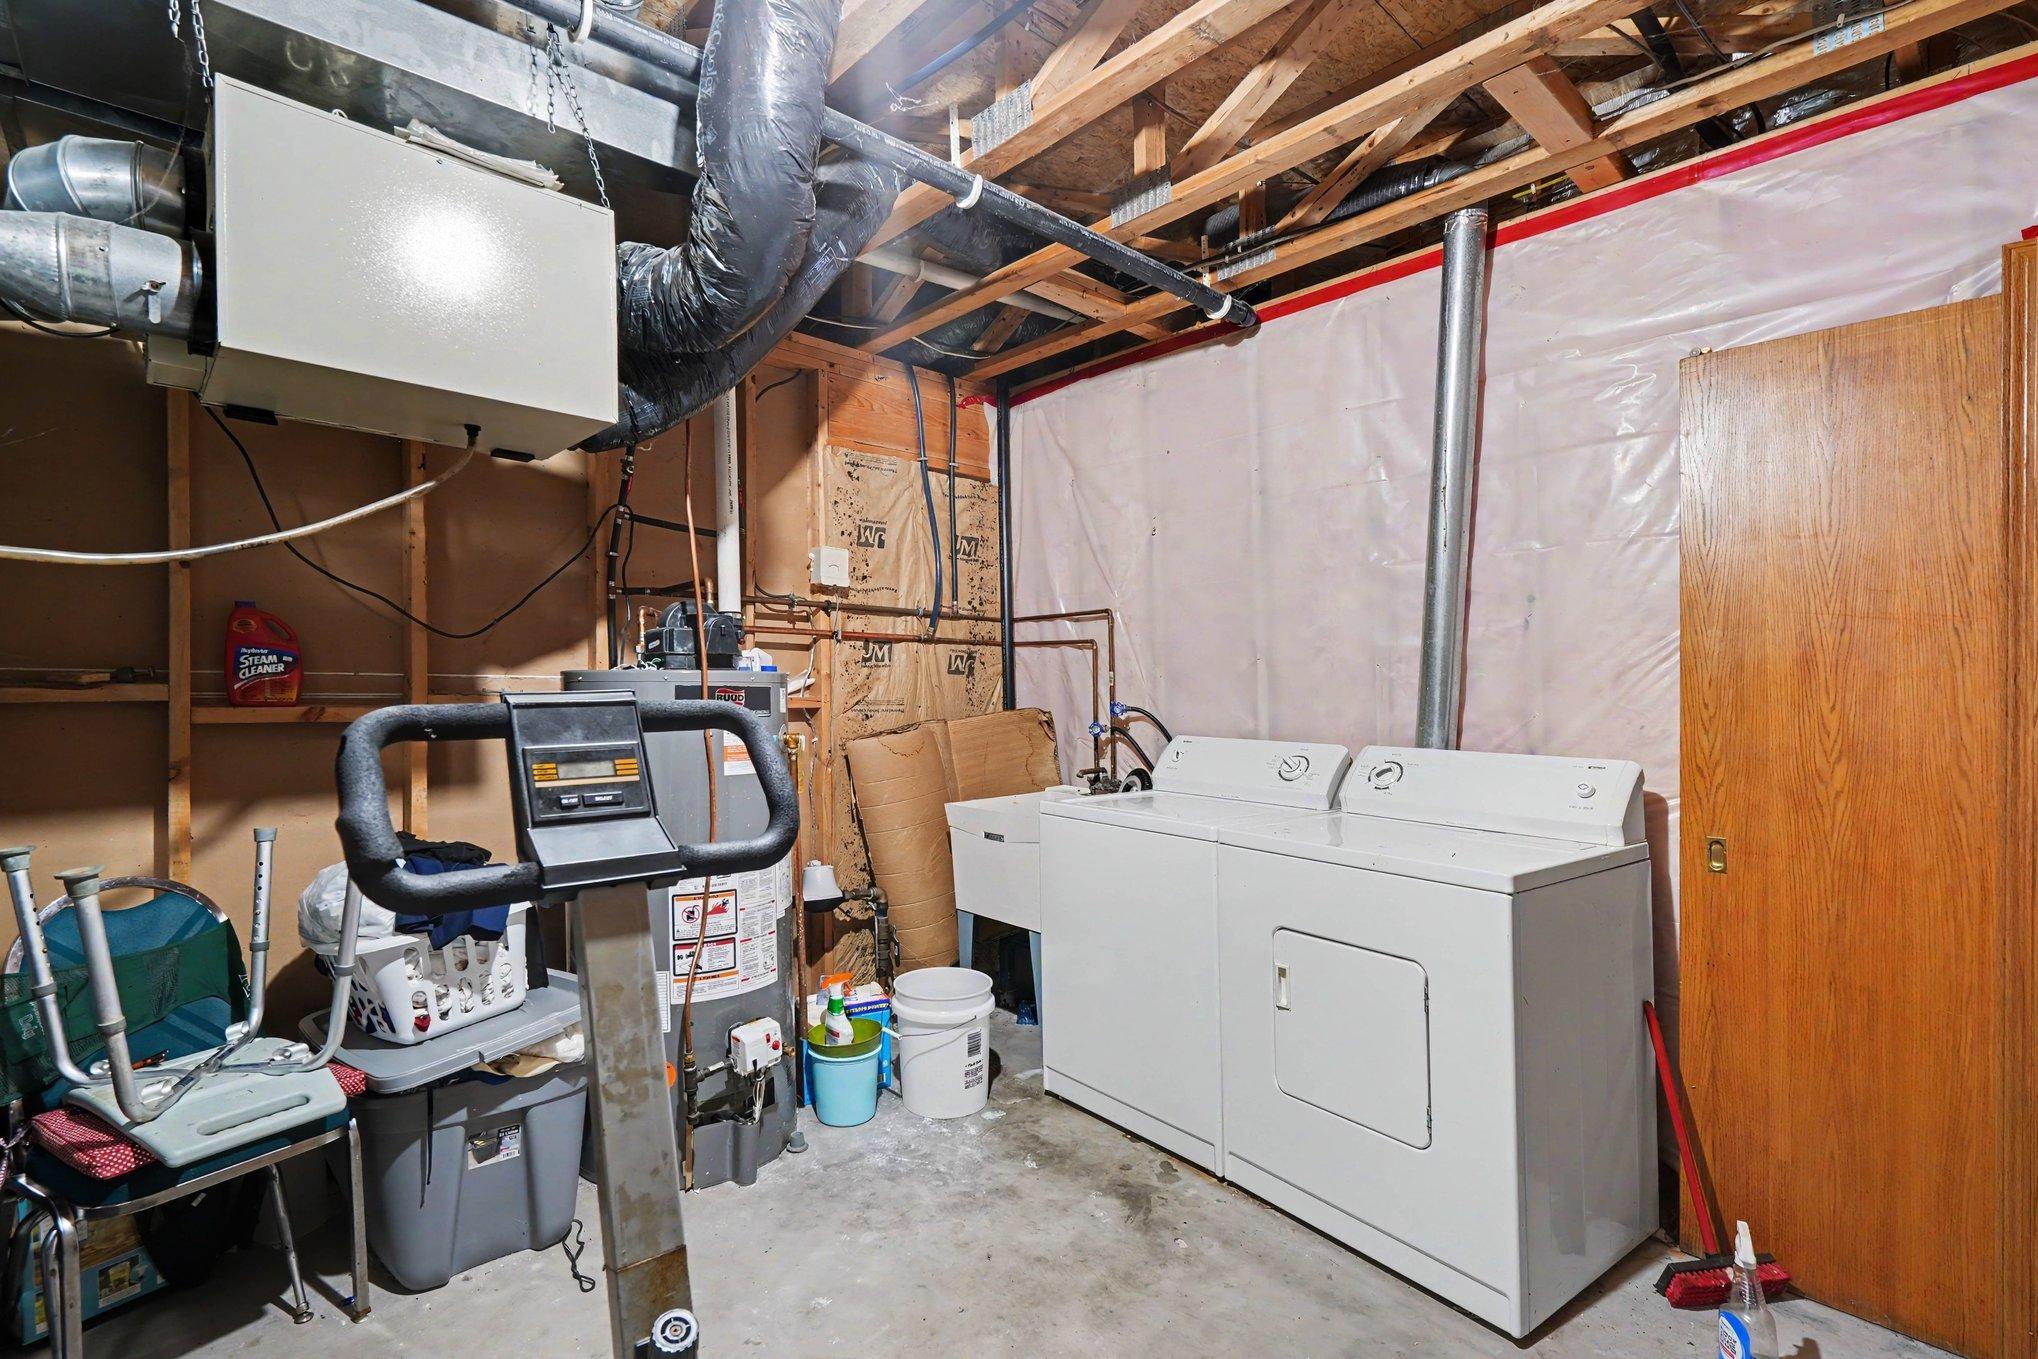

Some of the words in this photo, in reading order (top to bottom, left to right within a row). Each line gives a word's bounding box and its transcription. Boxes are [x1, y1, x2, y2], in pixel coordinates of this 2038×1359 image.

[240, 655, 278, 668] STEAM
[239, 663, 285, 679] CLEANER
[716, 694, 744, 702] RUUD
